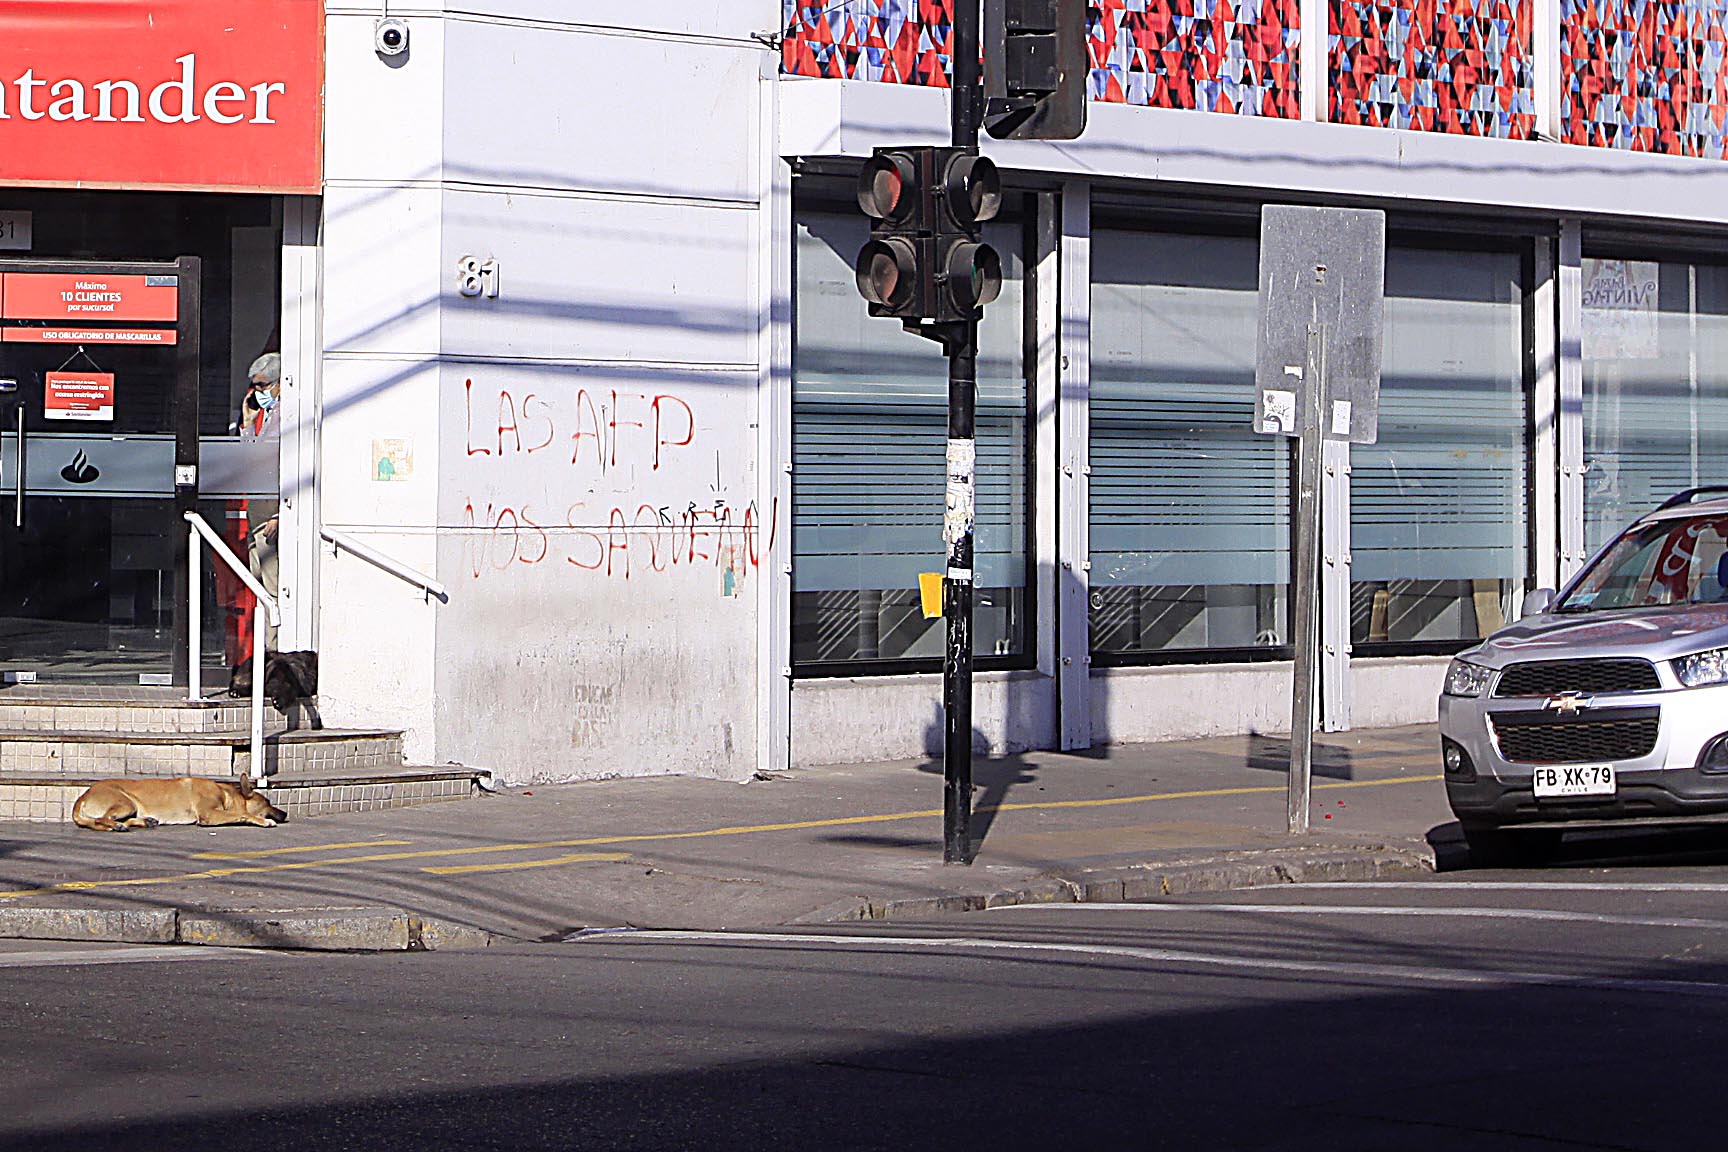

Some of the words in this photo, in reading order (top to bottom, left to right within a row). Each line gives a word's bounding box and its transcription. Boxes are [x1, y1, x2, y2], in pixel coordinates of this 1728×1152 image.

[60, 291, 73, 302] 10
[75, 291, 121, 302] CLIENTES
[457, 254, 500, 299] 81
[67, 304, 81, 313] por
[465, 378, 554, 456] LAS
[571, 389, 695, 471] AFP
[463, 496, 548, 579] NOS
